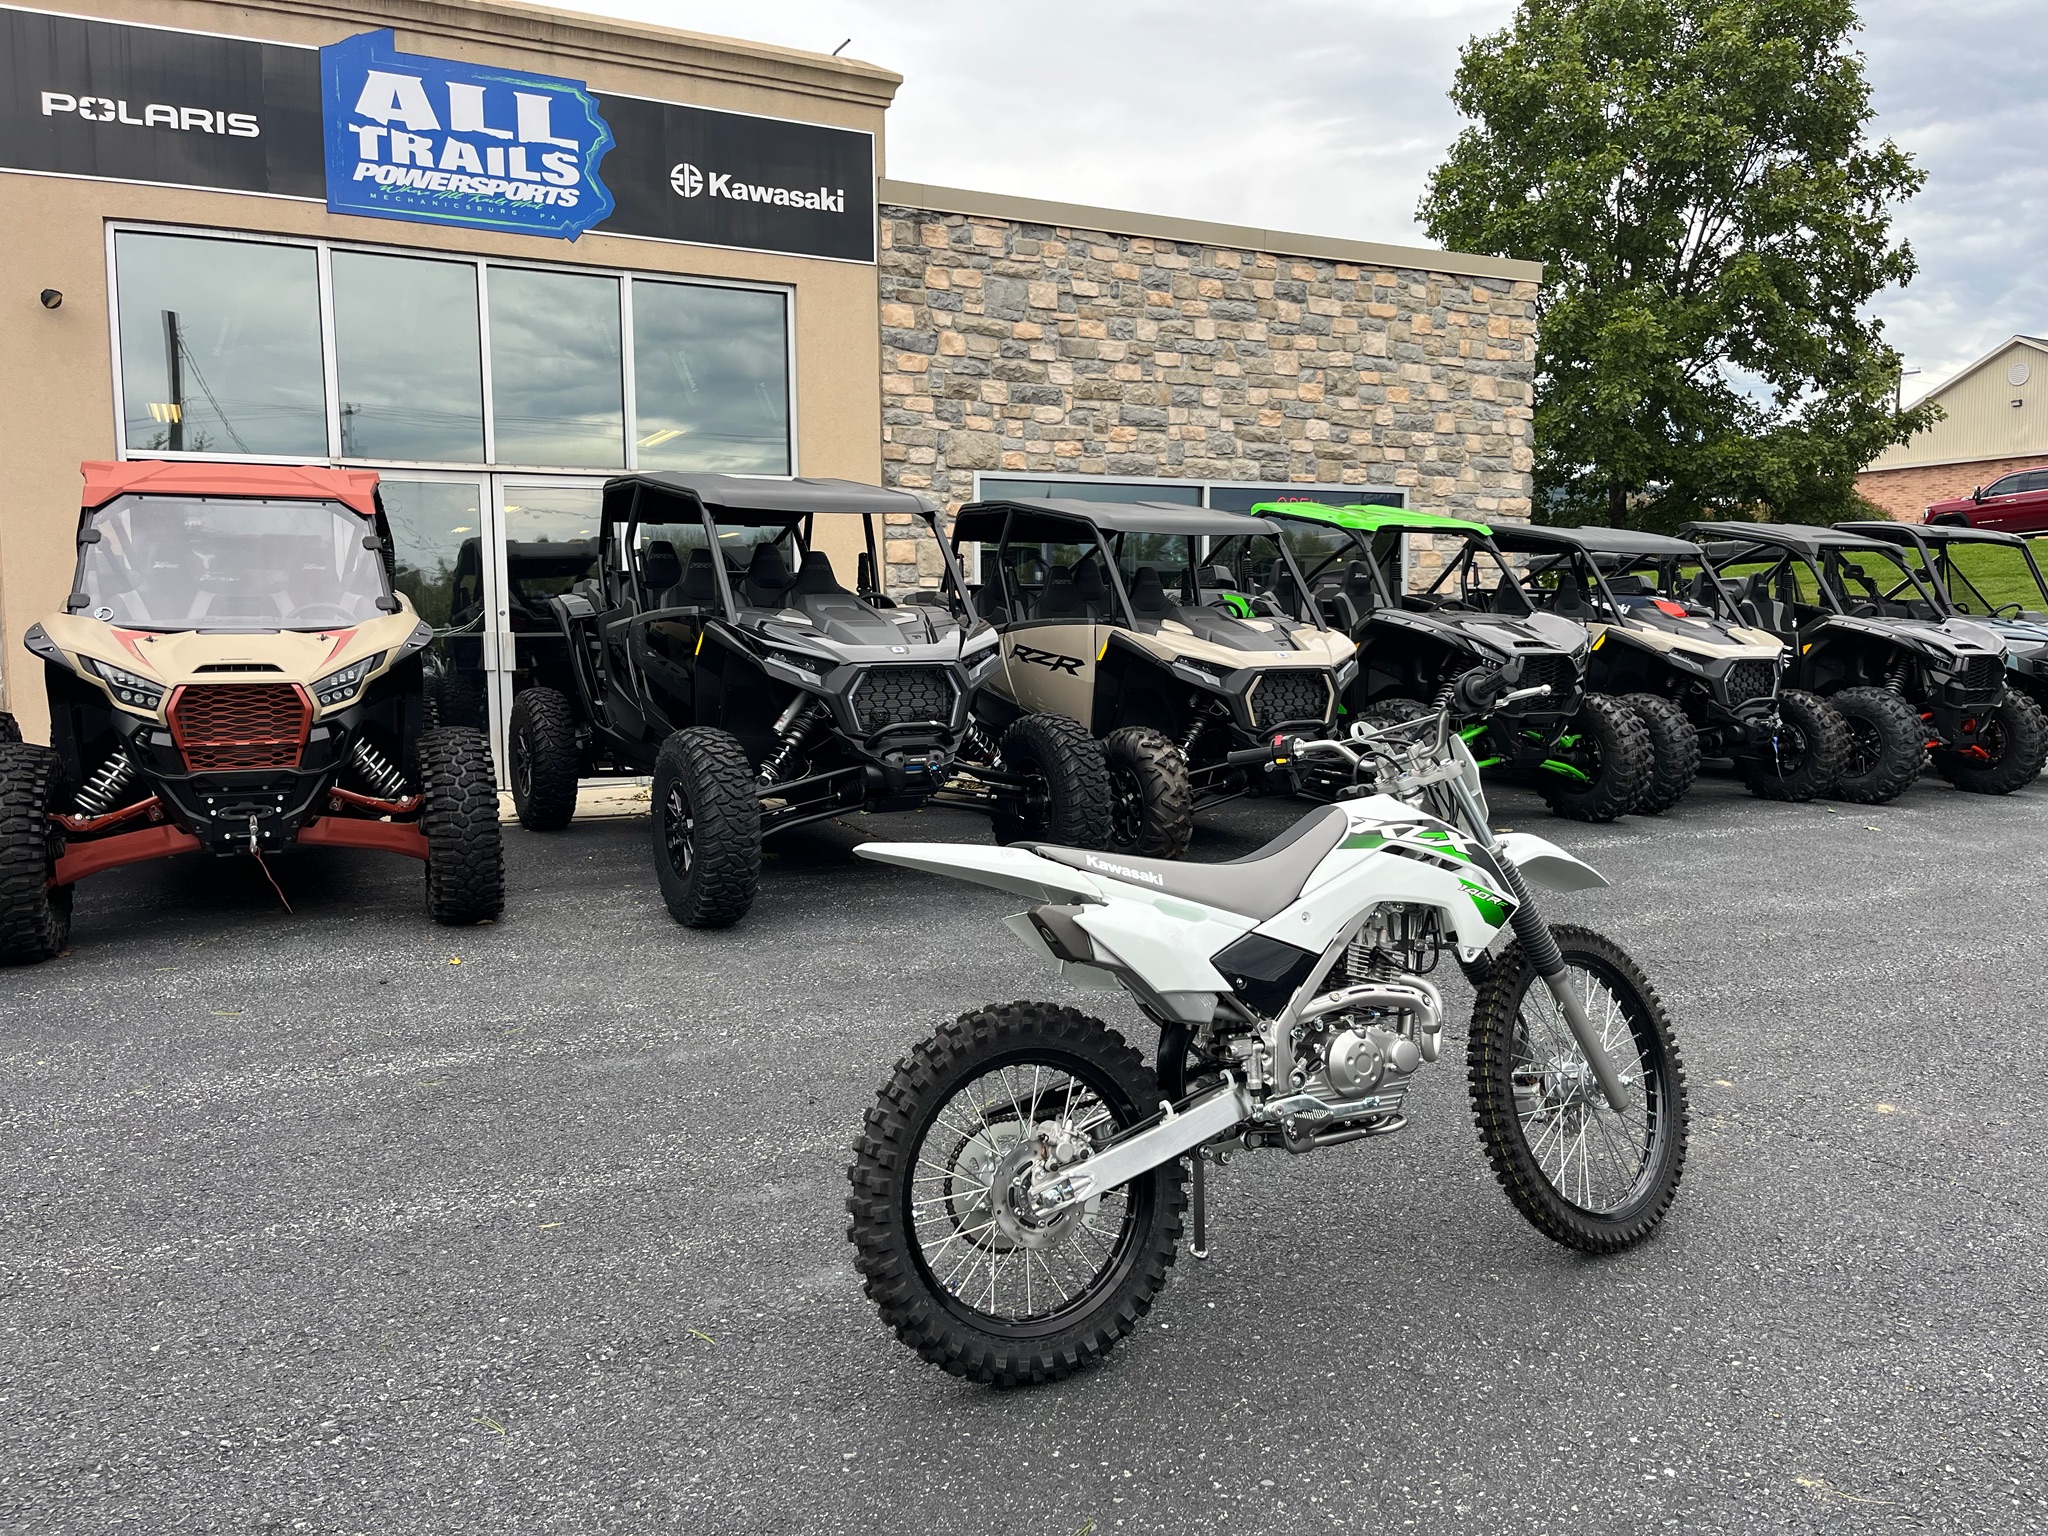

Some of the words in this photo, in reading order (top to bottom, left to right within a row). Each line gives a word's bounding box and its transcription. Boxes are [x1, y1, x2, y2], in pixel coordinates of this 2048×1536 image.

[40, 91, 260, 138] POLARIS
[354, 70, 579, 153] ALL
[349, 122, 580, 186] TRAILS
[352, 162, 580, 208] POWERSPORTS
[468, 192, 506, 206] Trails
[708, 172, 844, 213] Kawasaki
[540, 213, 557, 221] PA
[1009, 643, 1085, 676] RZR
[1350, 816, 1479, 856] KLX
[1085, 854, 1163, 886] Kawasaki
